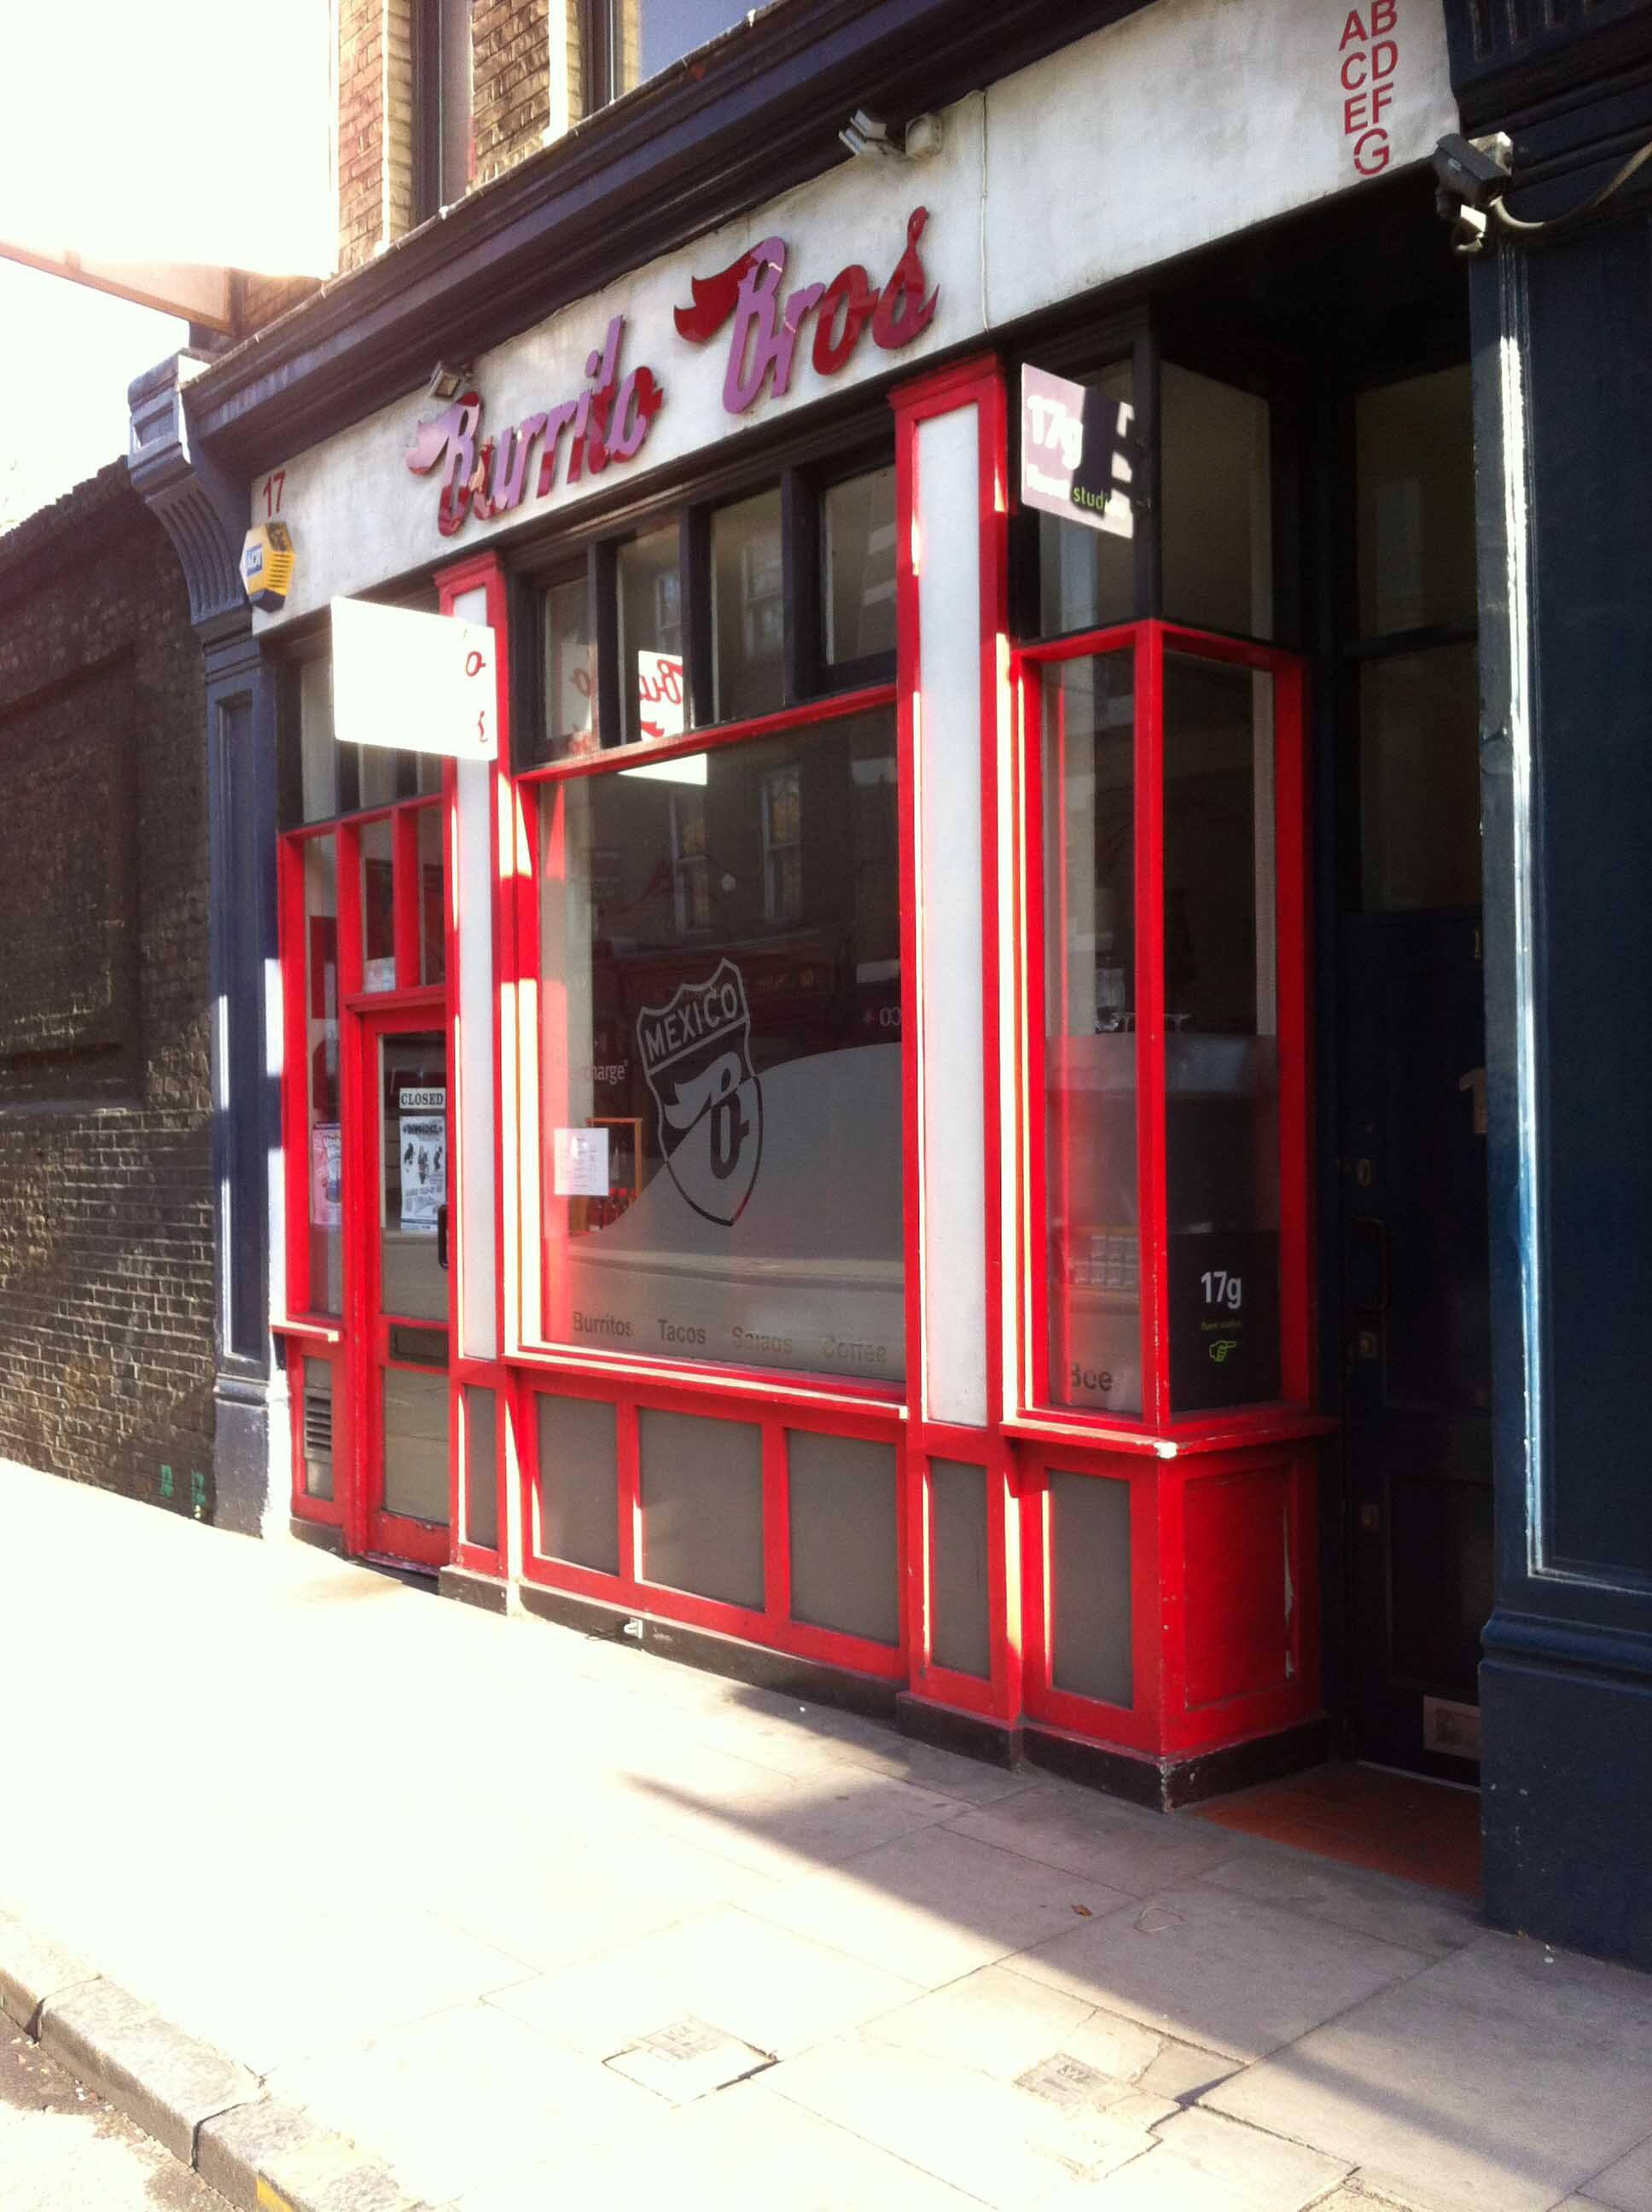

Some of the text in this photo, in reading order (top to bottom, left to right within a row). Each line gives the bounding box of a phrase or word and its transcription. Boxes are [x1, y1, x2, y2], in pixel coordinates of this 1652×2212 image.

[1353, 128, 1390, 175] G
[405, 206, 939, 538] Burrito Bros
[262, 470, 286, 518] 17
[644, 983, 737, 1062] MEXICO
[401, 1091, 444, 1106] CLOSED
[1201, 1270, 1242, 1309] 17g
[573, 1311, 634, 1338] Burritos
[657, 1318, 707, 1346] Tacos
